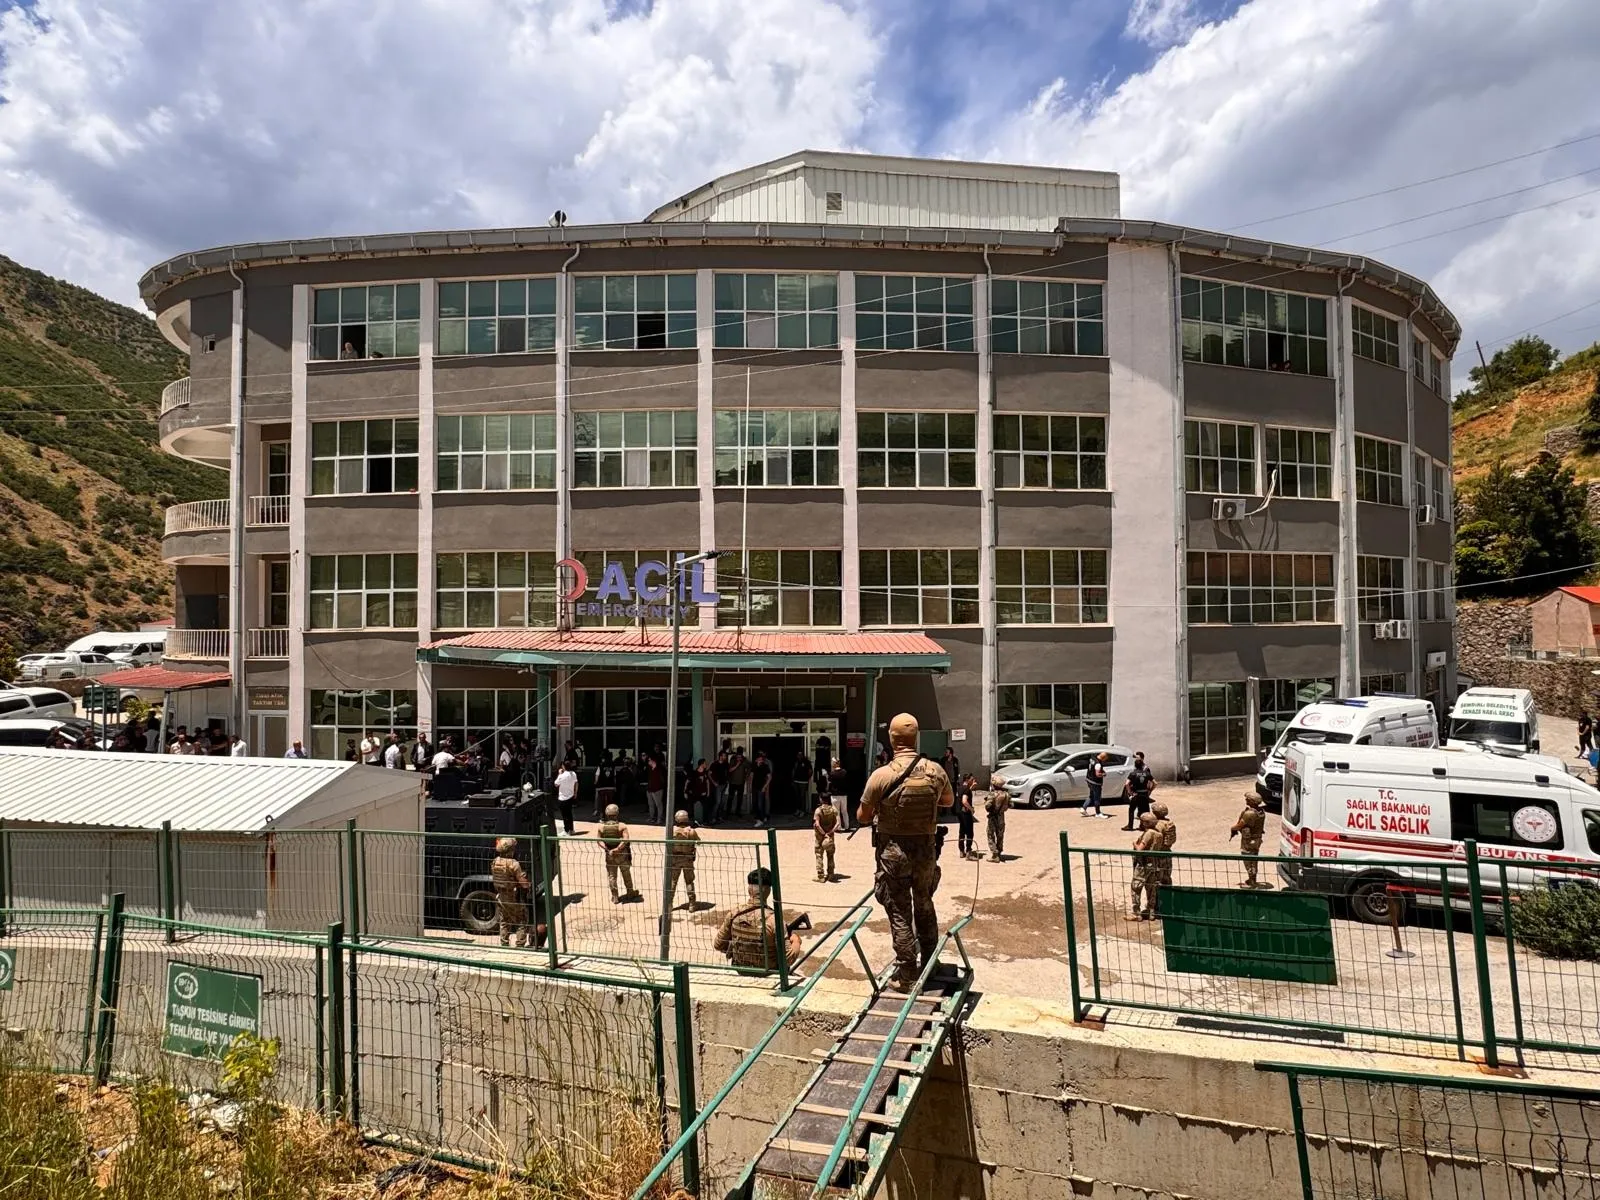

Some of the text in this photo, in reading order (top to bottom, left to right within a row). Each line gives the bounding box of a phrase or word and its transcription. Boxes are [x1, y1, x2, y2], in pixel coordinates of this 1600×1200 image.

[576, 602, 689, 618] EMERGENCY
[1378, 789, 1397, 800] T.C.
[1346, 799, 1431, 815] SAĞLIK BAKANLIĞI
[1380, 815, 1430, 835] SAĞLIK
[1320, 849, 1336, 857] 112
[1454, 845, 1549, 861] ABULANS
